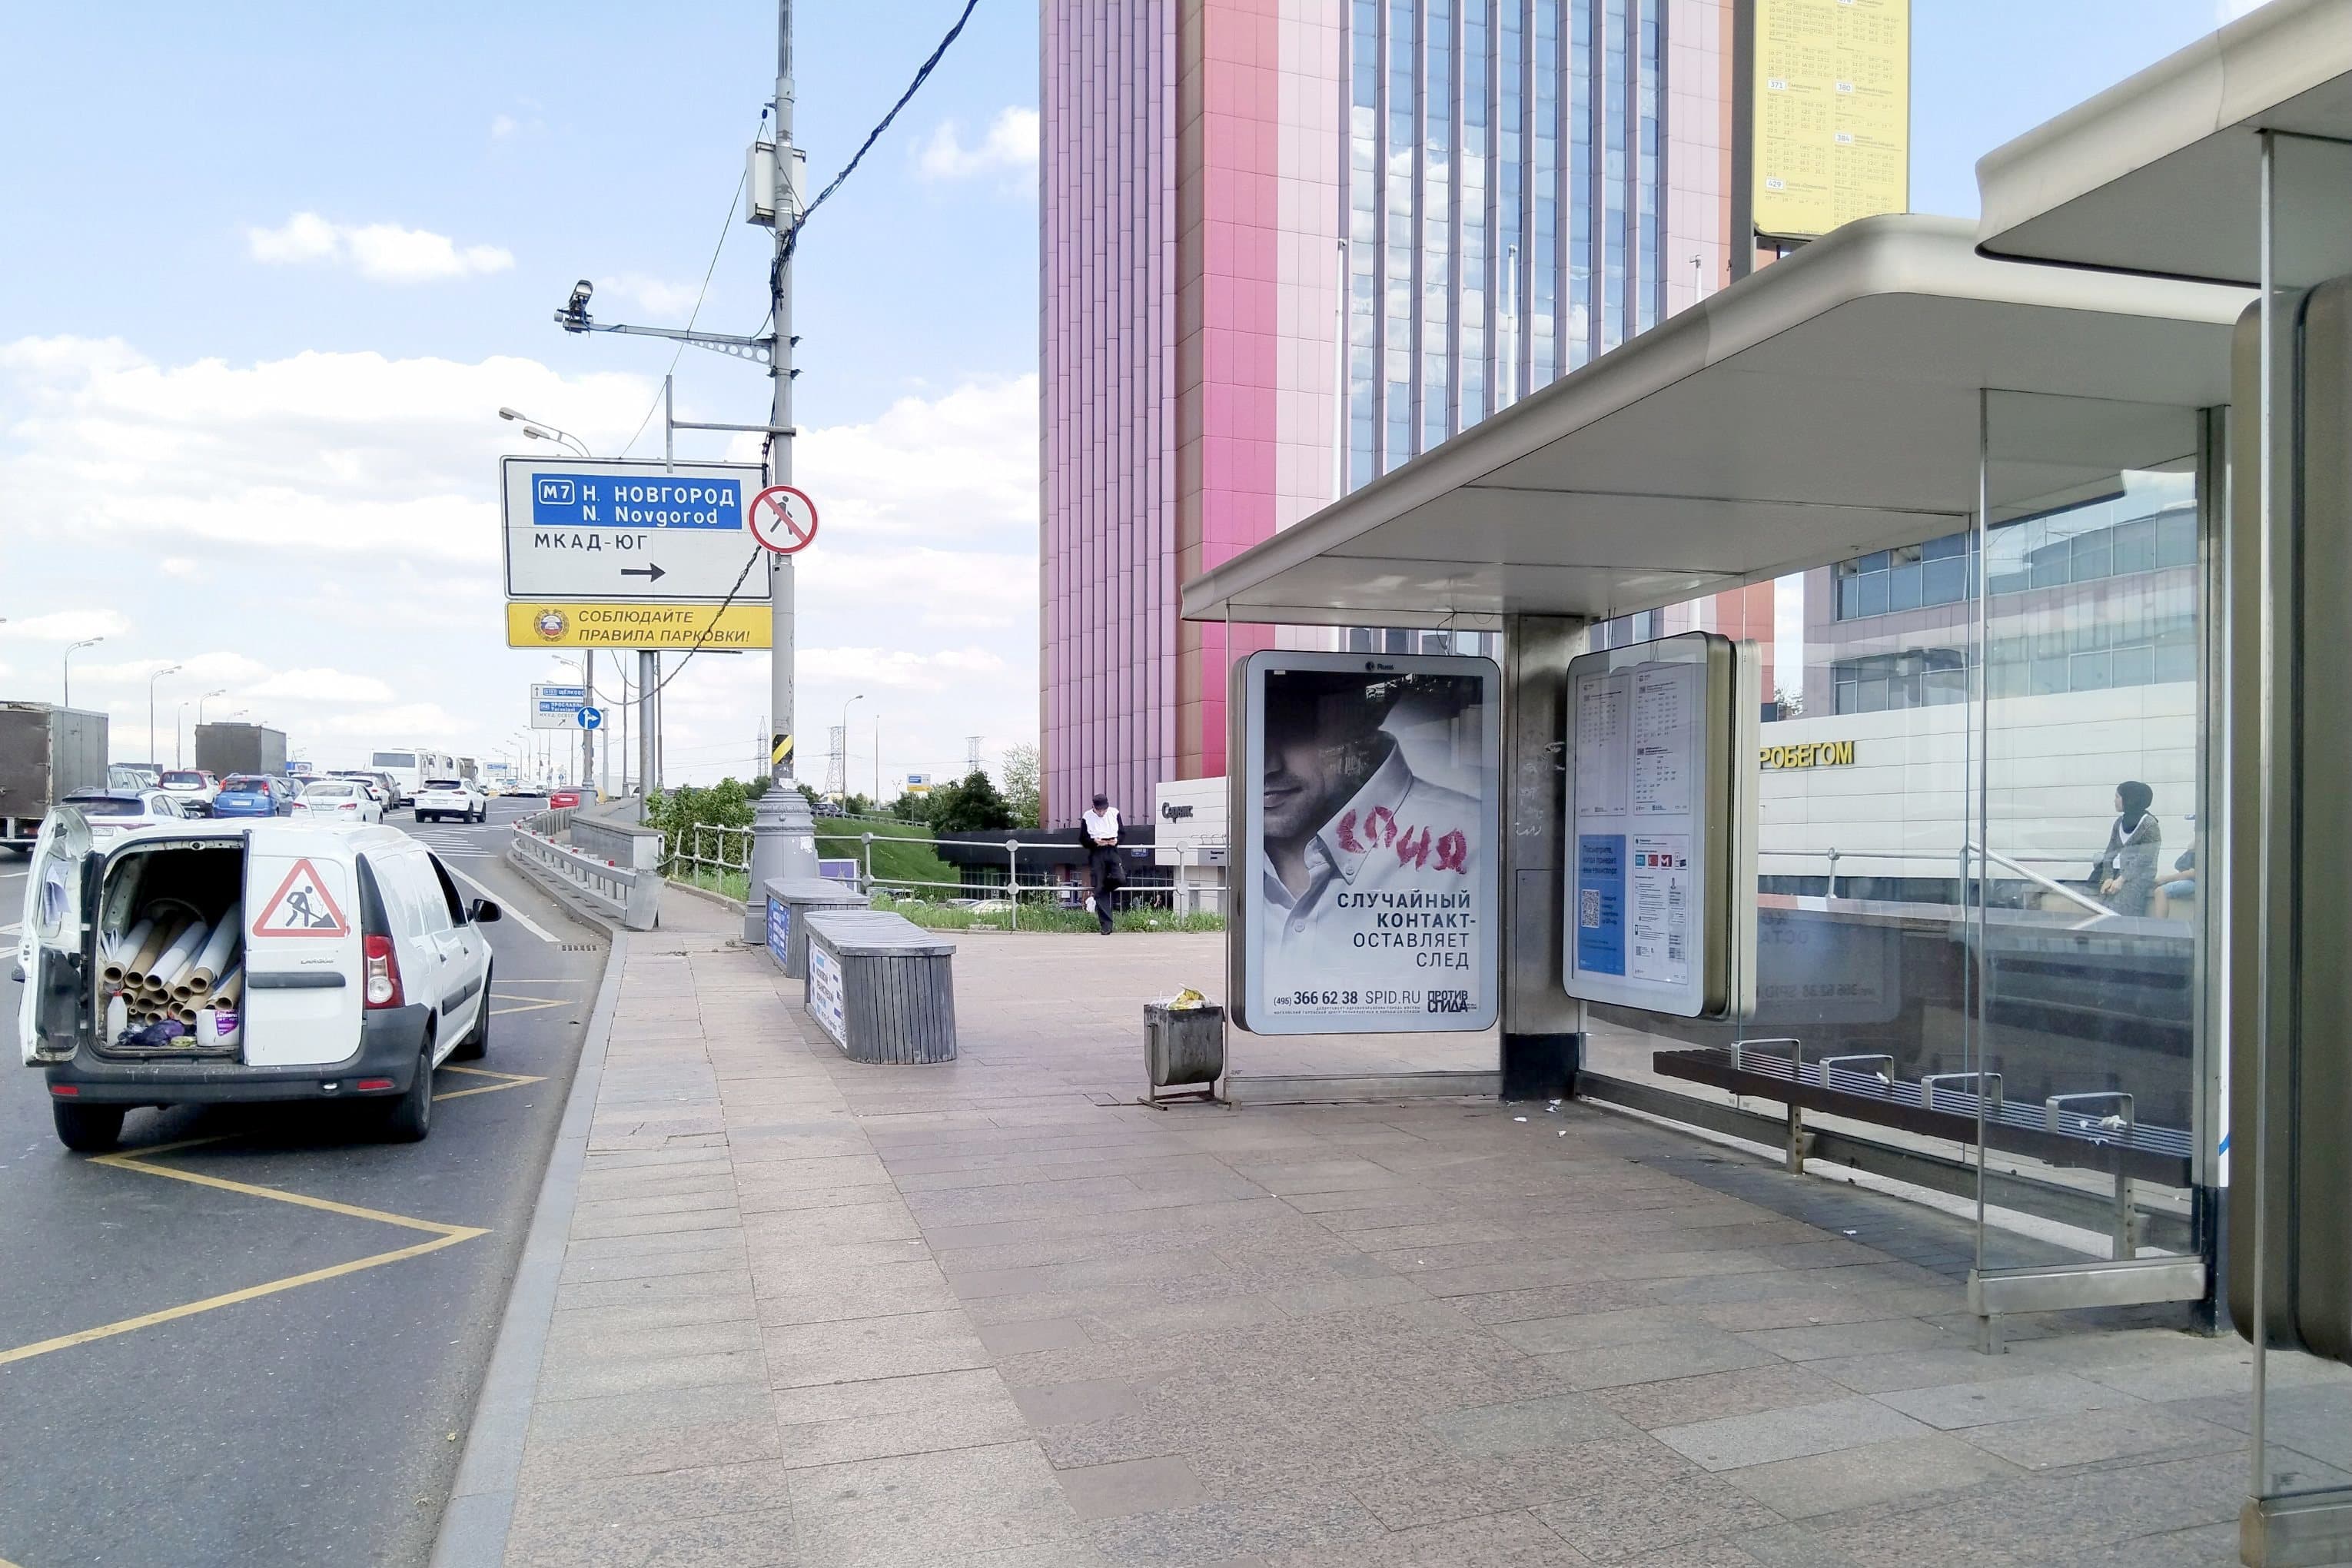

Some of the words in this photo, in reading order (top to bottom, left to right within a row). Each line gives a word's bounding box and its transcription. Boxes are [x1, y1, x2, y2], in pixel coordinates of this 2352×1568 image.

[543, 485, 570, 500] М7
[583, 485, 601, 502] Н.
[615, 486, 734, 507] НОВГОРОД
[583, 505, 601, 522] N.
[616, 507, 718, 527] Novgorod
[535, 533, 648, 551] МКАД-ЮГ
[578, 608, 694, 623] СОБЛЮДАЙТЕ
[578, 630, 655, 643] ПРАВИЛА
[659, 630, 750, 643] ПАРКОВКИ!
[1337, 889, 1470, 909] СЛУЧАЙНЫЙ
[1353, 932, 1470, 948] ОСТАВЛЯЕТ
[1416, 952, 1469, 970] СЛЕД
[1274, 996, 1292, 1006] (495)
[1294, 991, 1319, 1005] 366
[1322, 991, 1338, 1005] 62
[1341, 991, 1358, 1005] 38
[1365, 990, 1420, 1005] SPID.RU
[1427, 990, 1468, 1000] ПРОТИВ
[1427, 999, 1468, 1013] СПИДА
